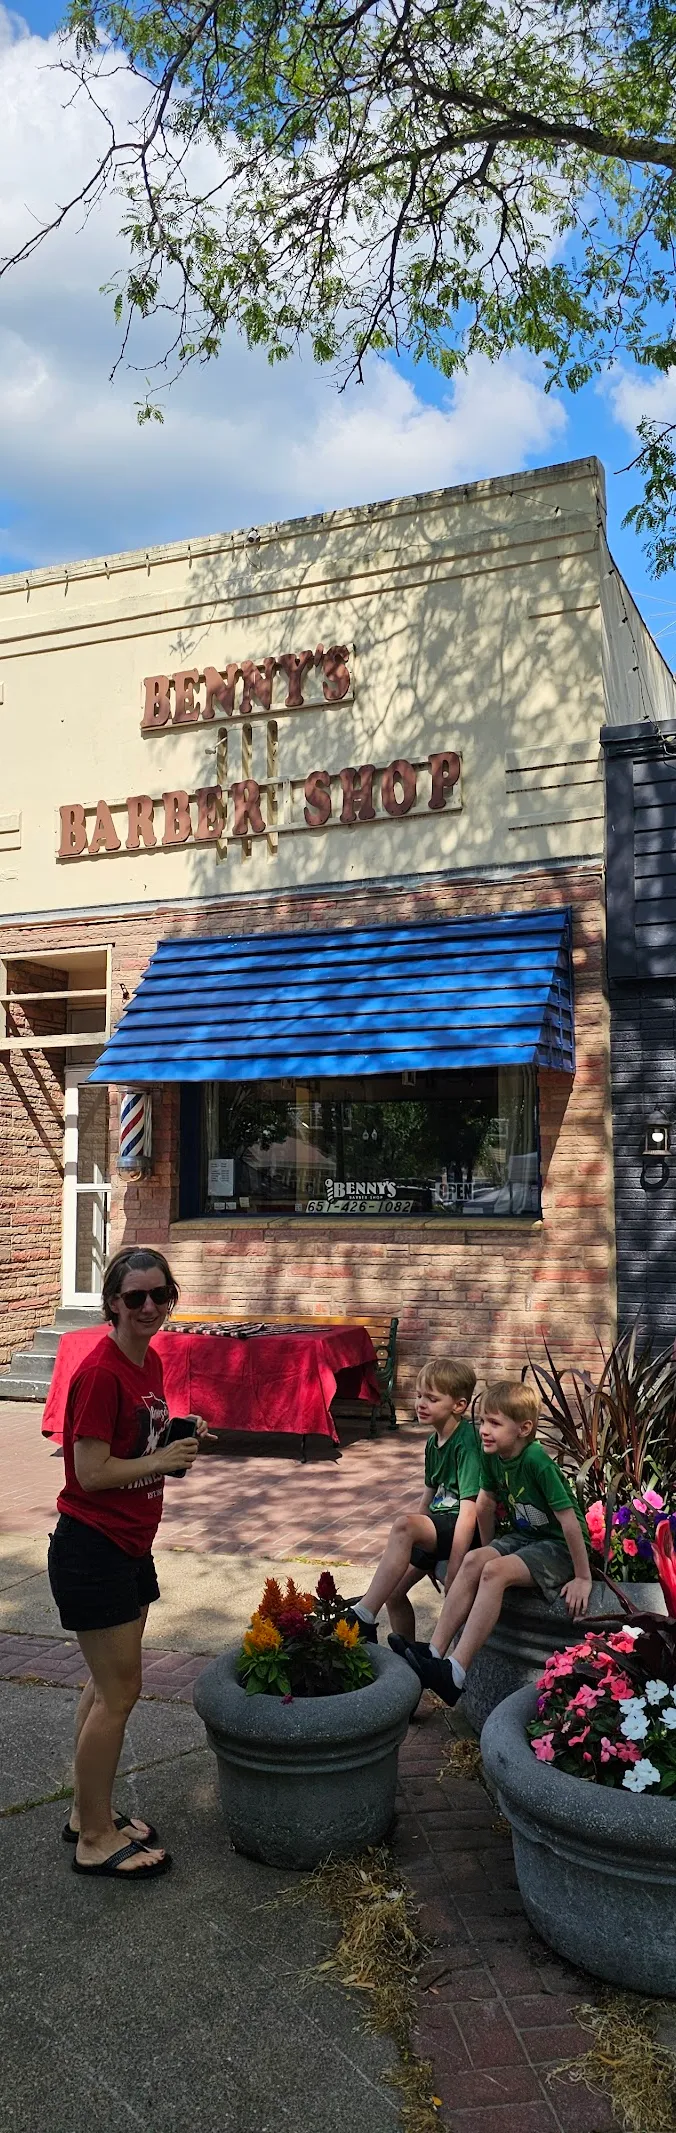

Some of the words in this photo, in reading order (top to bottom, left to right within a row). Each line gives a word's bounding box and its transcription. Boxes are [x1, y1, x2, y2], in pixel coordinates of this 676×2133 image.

[139, 643, 351, 728] BENNY'S
[58, 778, 266, 857] BARBER
[303, 751, 461, 826] SHOP
[333, 1181, 397, 1198] BENNY'S
[439, 1183, 473, 1200] OPEN
[307, 1201, 412, 1212] 651-426-1082
